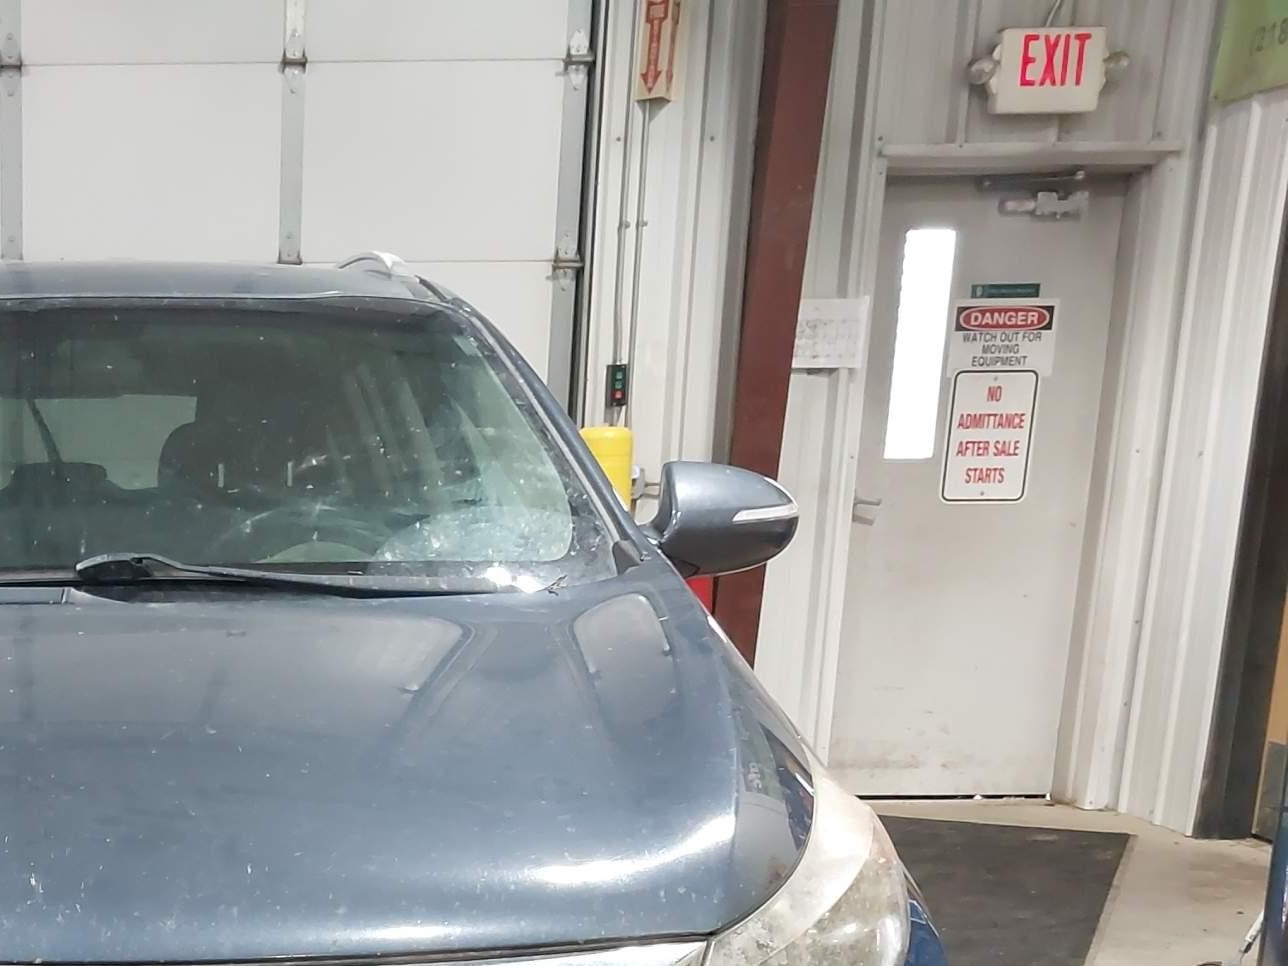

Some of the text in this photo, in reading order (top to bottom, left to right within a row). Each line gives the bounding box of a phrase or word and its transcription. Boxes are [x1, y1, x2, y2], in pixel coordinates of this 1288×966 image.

[1020, 33, 1092, 87] EXIT
[970, 312, 1039, 326] DANGER
[962, 331, 1042, 343] WATCH OUT FOR
[982, 344, 1020, 355] MOVING
[971, 356, 1028, 367] EQUIPMENT
[986, 385, 1003, 402] NO
[956, 412, 1026, 429] ADMITTANCE
[956, 439, 1021, 457] AFTER SALE
[964, 467, 1006, 484] STARTS
